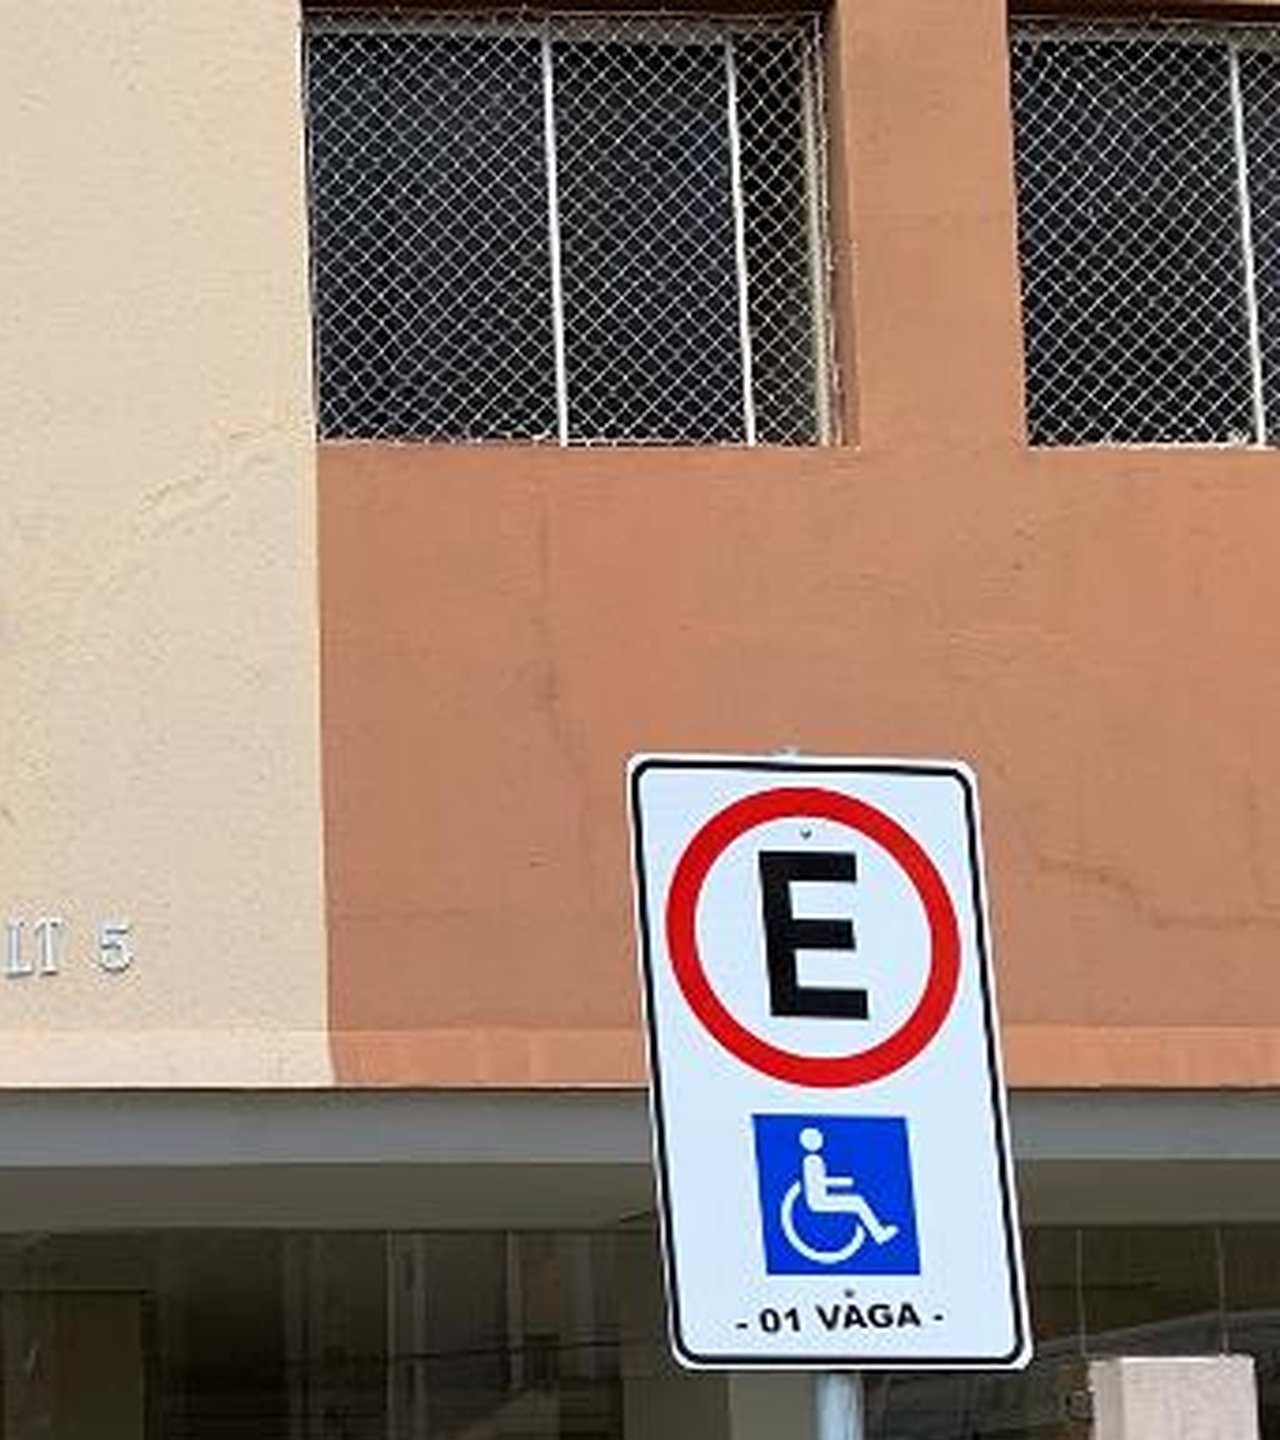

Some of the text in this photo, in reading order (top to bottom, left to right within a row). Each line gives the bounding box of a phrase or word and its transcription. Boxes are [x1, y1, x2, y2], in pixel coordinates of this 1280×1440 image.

[5, 917, 66, 977] LT
[97, 921, 135, 976] 5
[758, 850, 870, 1021] E
[759, 1307, 801, 1334] 01
[815, 1302, 922, 1331] VAGA
